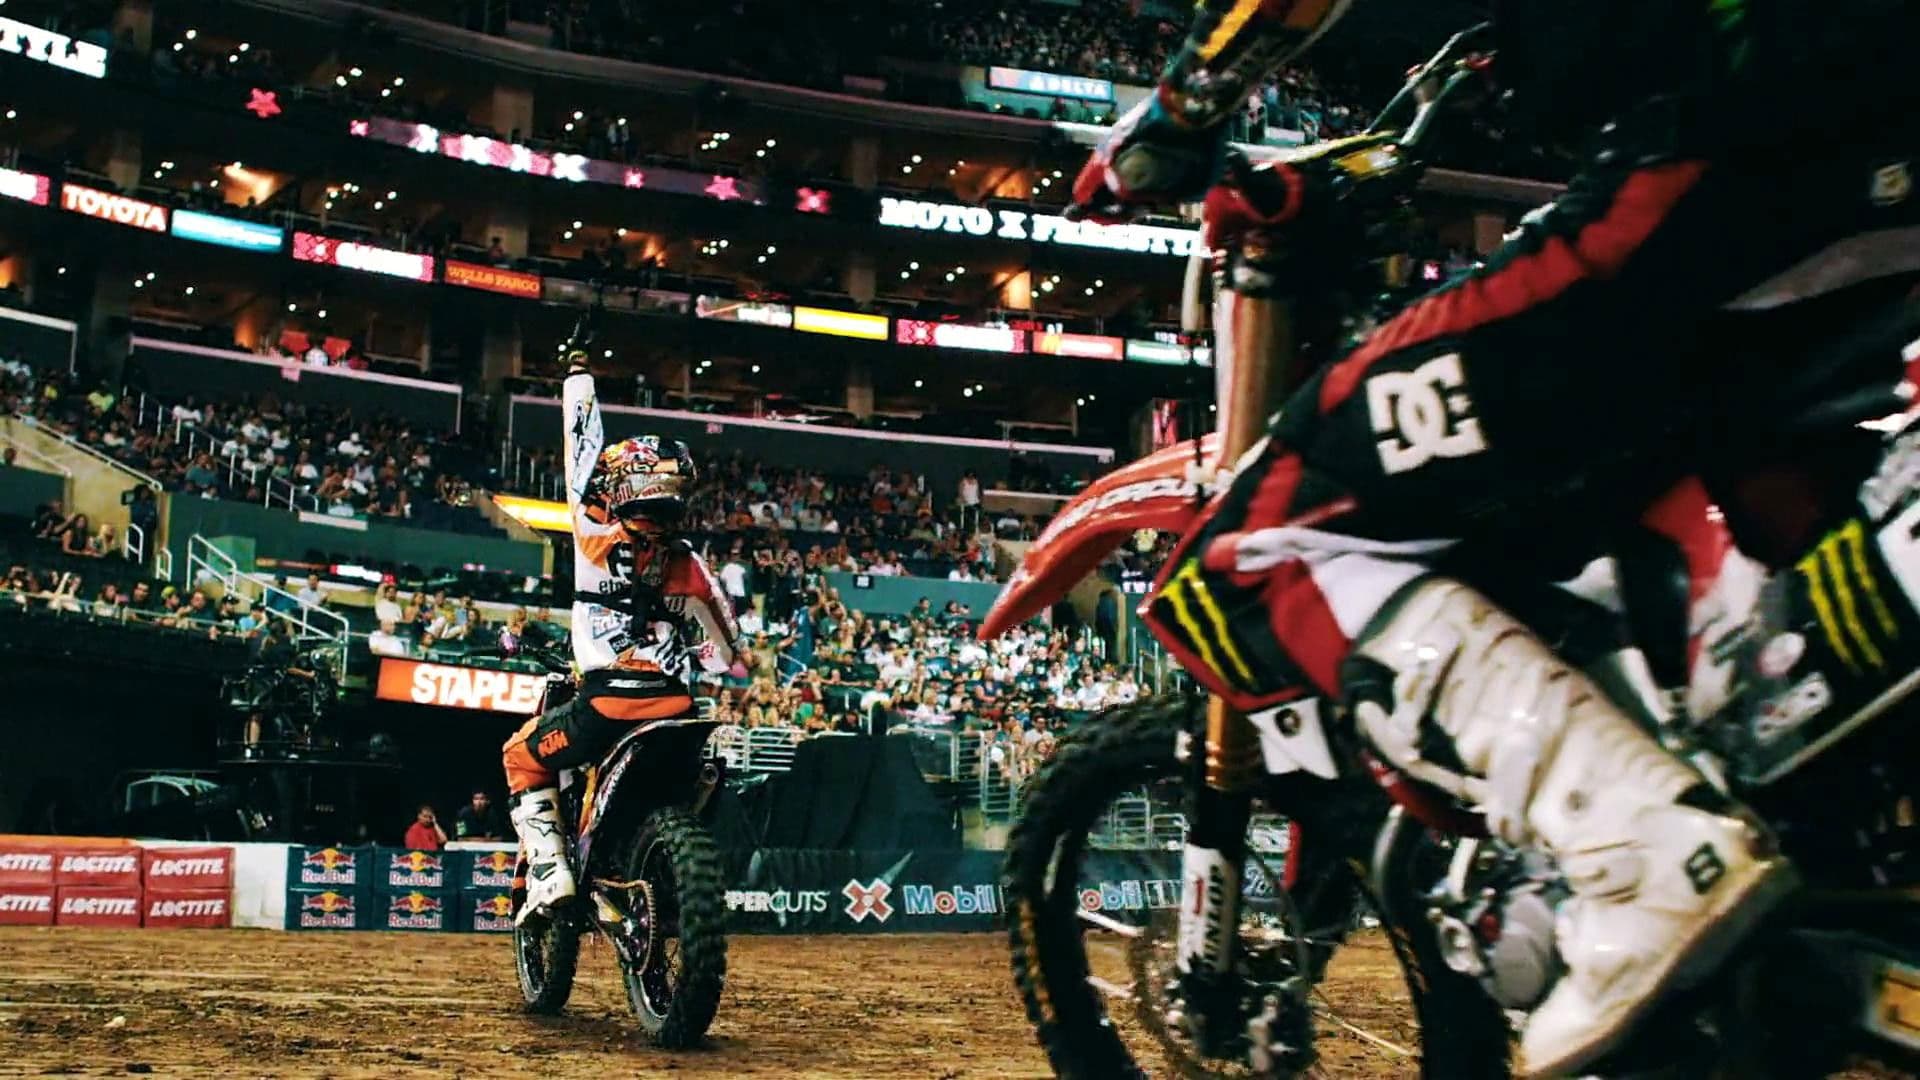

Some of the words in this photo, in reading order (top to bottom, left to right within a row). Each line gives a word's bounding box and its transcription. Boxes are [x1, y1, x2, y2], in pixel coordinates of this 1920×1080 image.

[0, 16, 107, 79] TYLE
[63, 183, 167, 232] TOYOTA
[880, 197, 993, 235] MOTO
[997, 210, 1027, 240] X
[448, 265, 494, 285] WELLS
[495, 273, 540, 292] FARGO
[0, 853, 52, 871] CTITE
[302, 868, 328, 883] Red
[328, 869, 356, 884] Bull
[389, 870, 415, 886] Red
[415, 871, 443, 887] Bull
[473, 870, 498, 886] Red
[0, 895, 51, 912] CTITE
[724, 888, 830, 913] PERCUTS
[903, 884, 997, 915] Mobil
[1079, 880, 1144, 911] obil
[301, 912, 327, 927] Red
[327, 913, 355, 927] Bull
[389, 912, 415, 928] Red
[415, 913, 442, 928] Bull
[475, 915, 500, 930] Red
